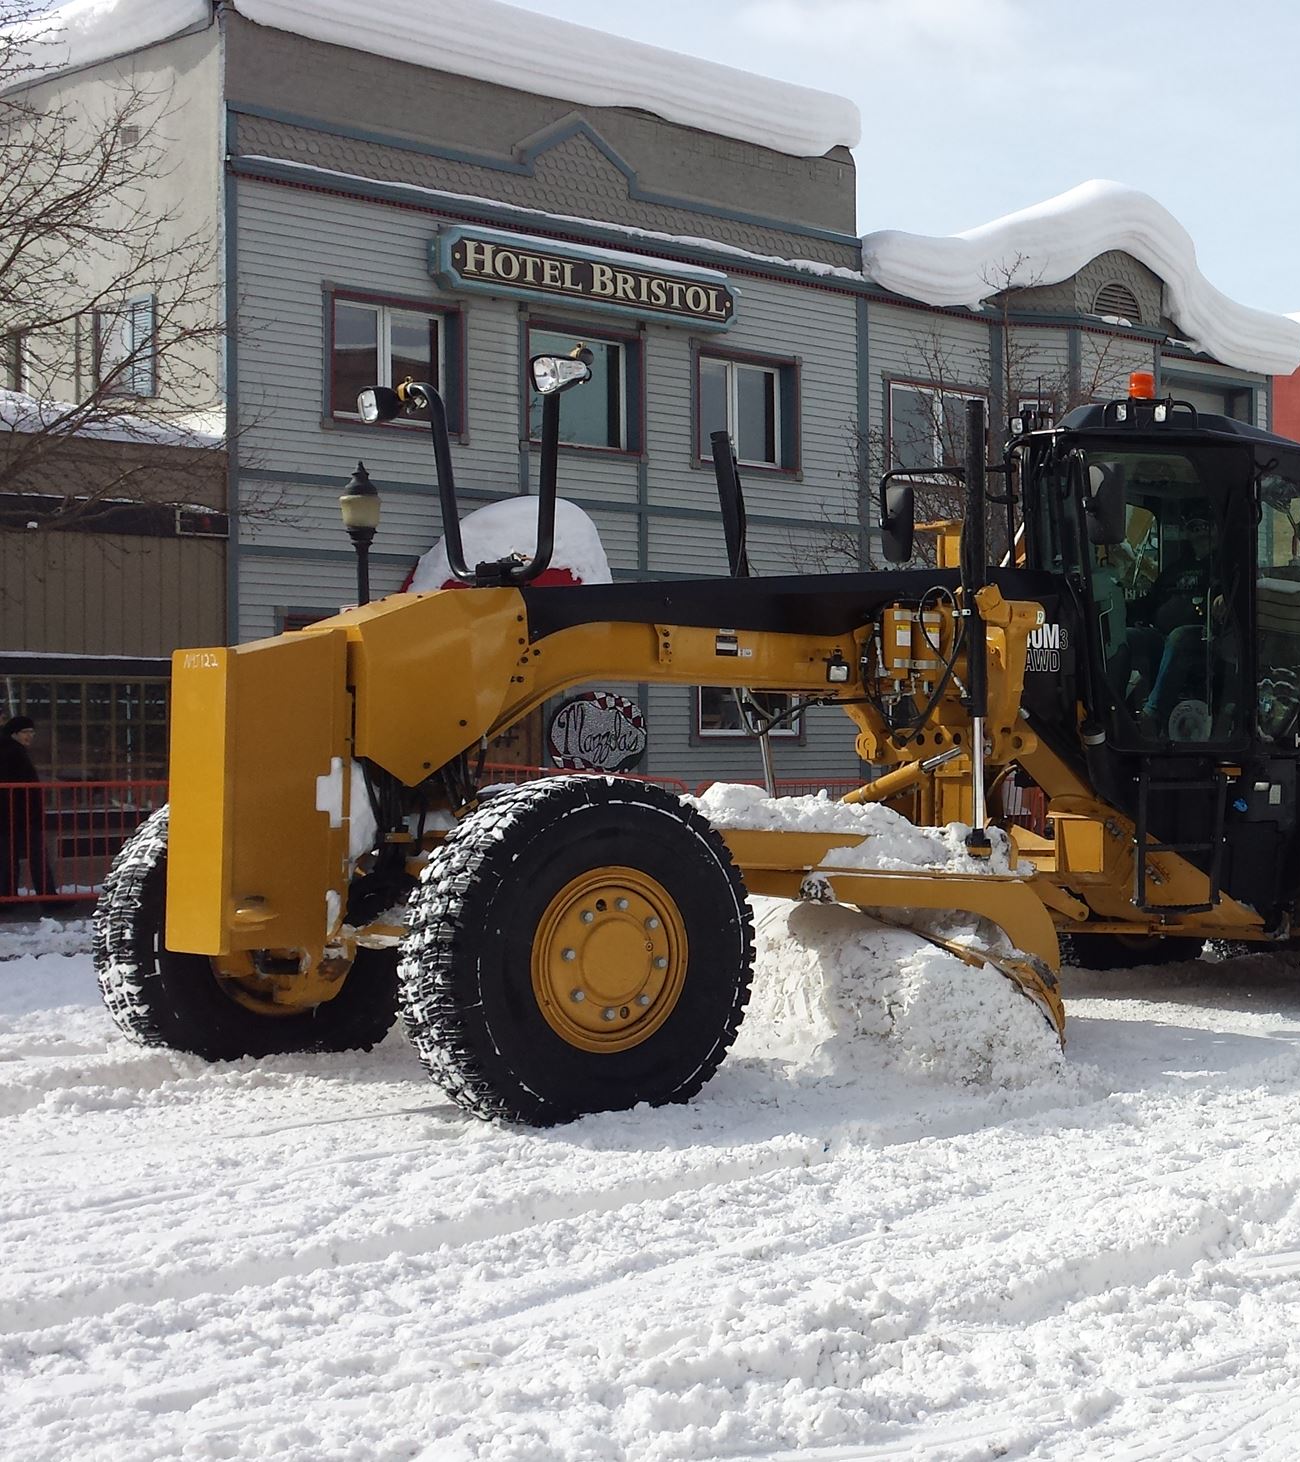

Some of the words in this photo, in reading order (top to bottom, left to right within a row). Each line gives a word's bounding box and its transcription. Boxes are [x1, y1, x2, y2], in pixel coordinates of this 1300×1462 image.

[463, 239, 583, 291] HOTEL
[590, 262, 726, 317] BRISTOL
[1025, 648, 1061, 672] AWD
[557, 703, 639, 764] Mazzola's
